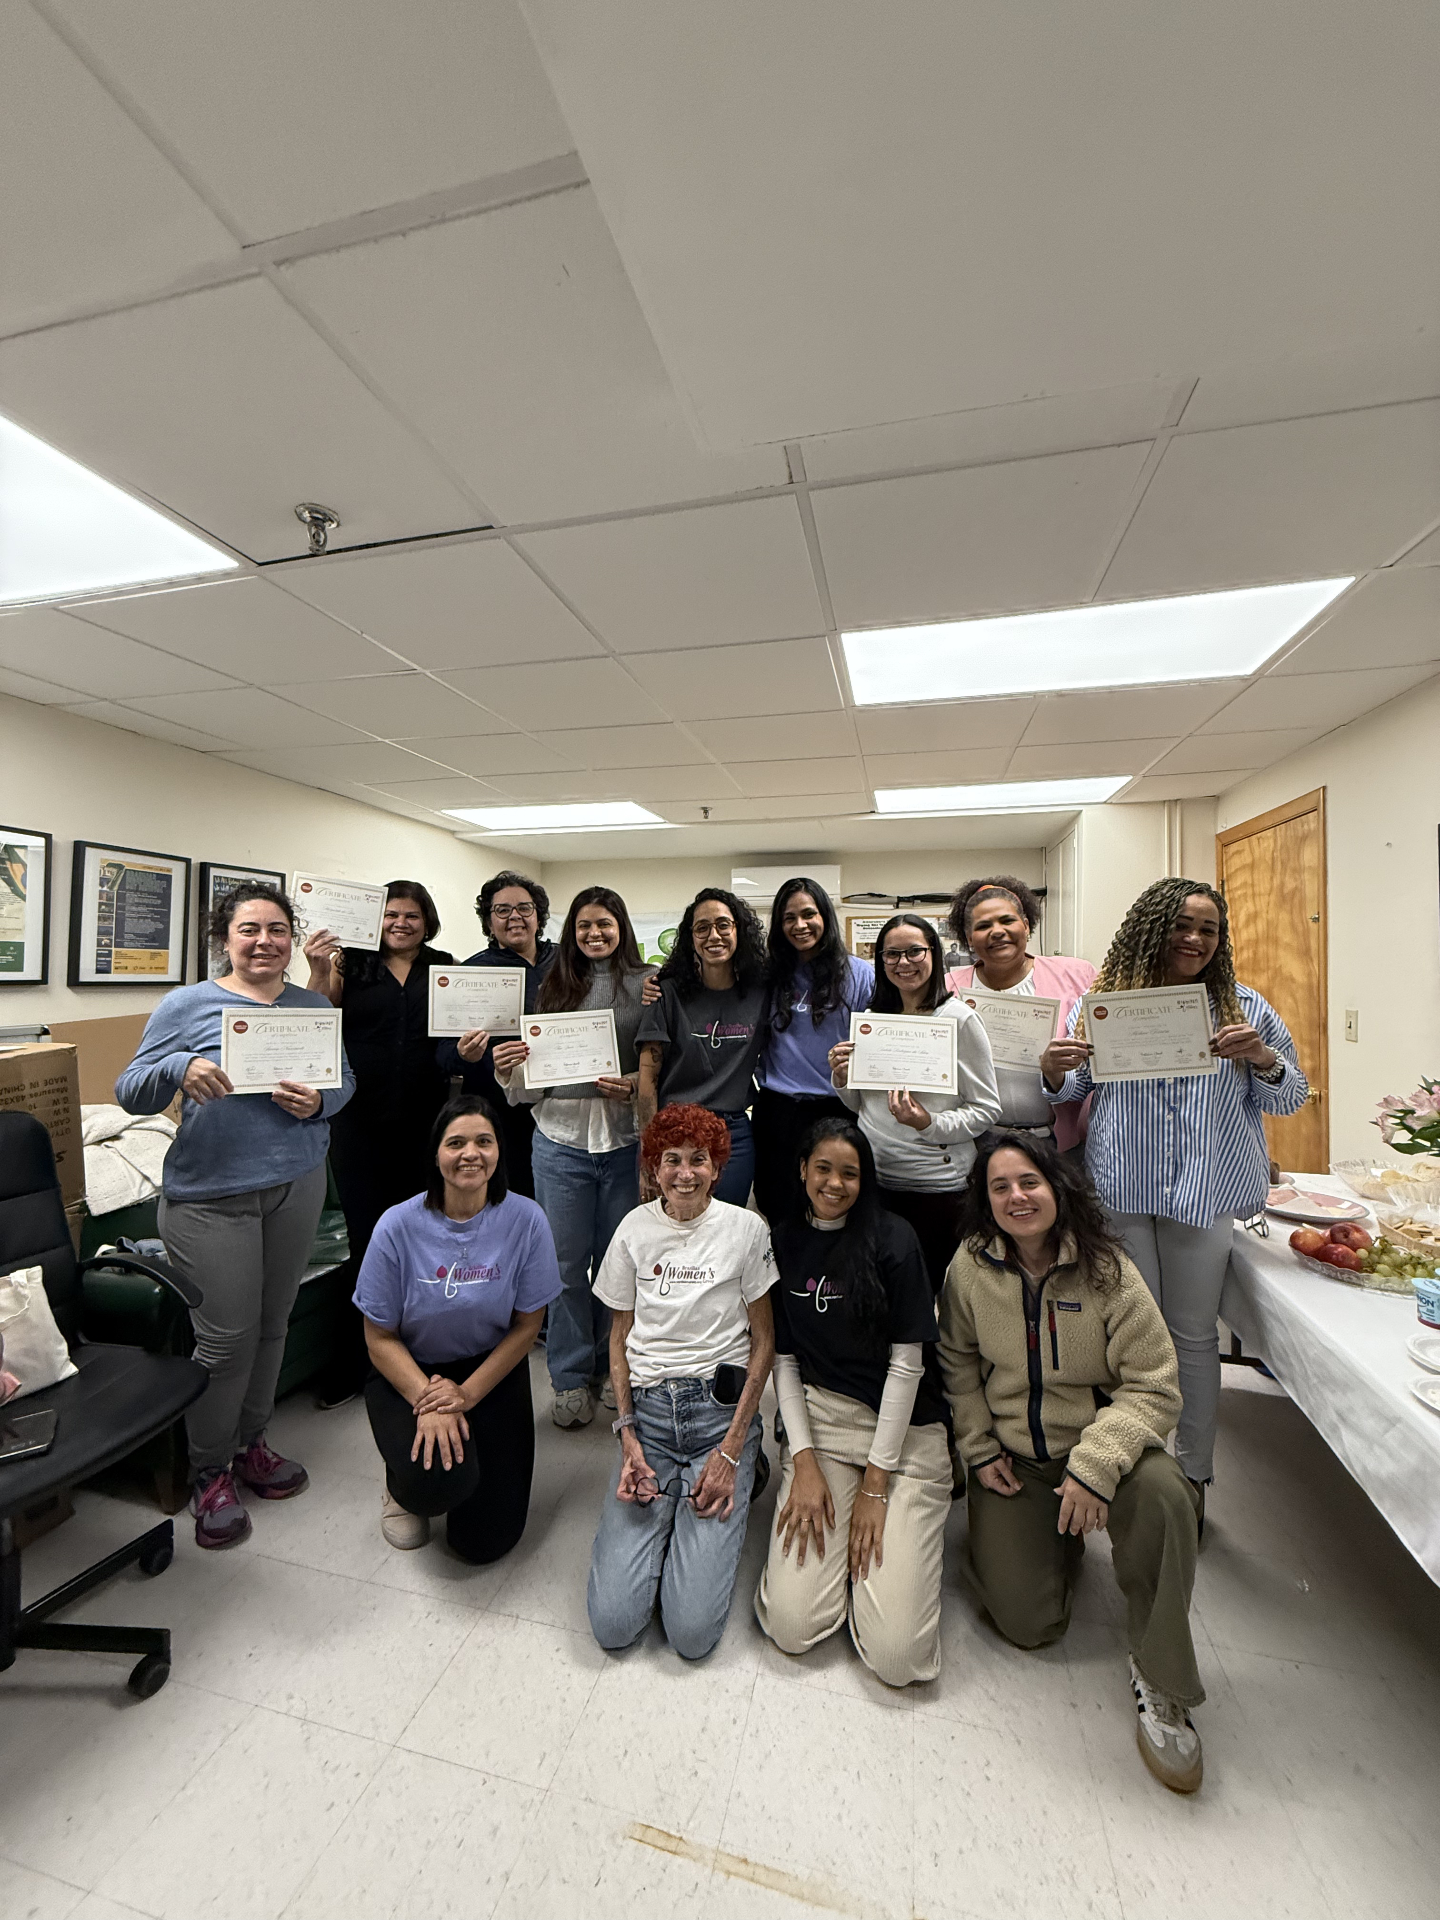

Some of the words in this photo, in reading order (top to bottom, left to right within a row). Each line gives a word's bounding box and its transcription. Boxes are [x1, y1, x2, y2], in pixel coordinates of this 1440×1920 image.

[315, 886, 362, 901] CERTIFICATE
[453, 978, 498, 988] CERTIFICATE
[980, 1003, 1029, 1018] CERTIFICATE
[1113, 1006, 1172, 1019] CERTIFICATE
[253, 1022, 310, 1034] CERTIFICATE
[545, 1025, 589, 1036] CERTIFICATE
[875, 1026, 927, 1038] CERTIFICATE
[29, 1081, 39, 1090] IN
[44, 1076, 68, 1087] MADE
[454, 1264, 501, 1281] Women's
[668, 1266, 715, 1280] Women's
